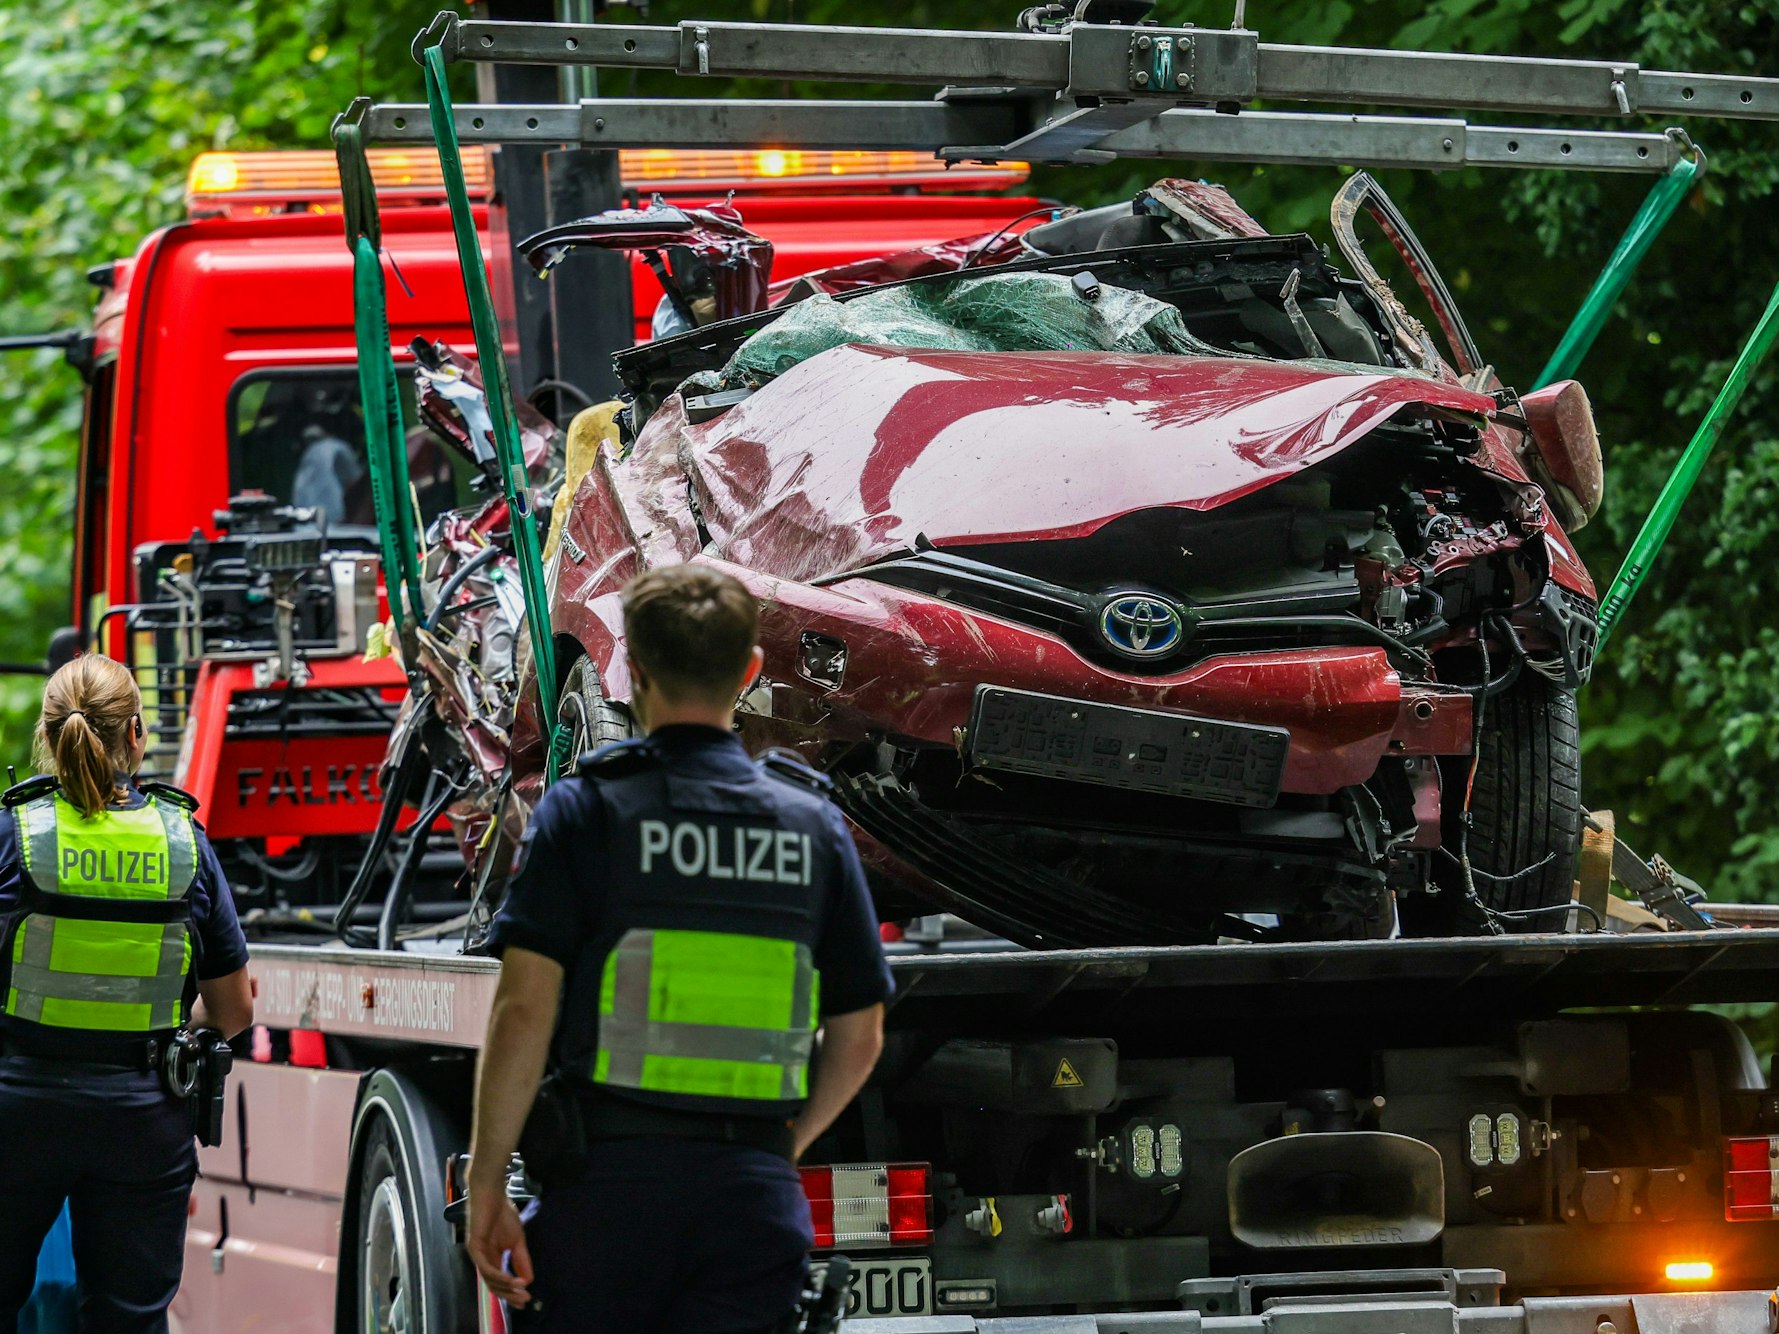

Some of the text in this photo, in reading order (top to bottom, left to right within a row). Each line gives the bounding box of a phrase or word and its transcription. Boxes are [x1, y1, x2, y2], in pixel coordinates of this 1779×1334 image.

[62, 847, 165, 884] POLIZEI
[640, 820, 812, 886] POLIZEI
[374, 976, 455, 1033] BERGUNGSDIENST
[1279, 1226, 1404, 1246] RINGFEDER
